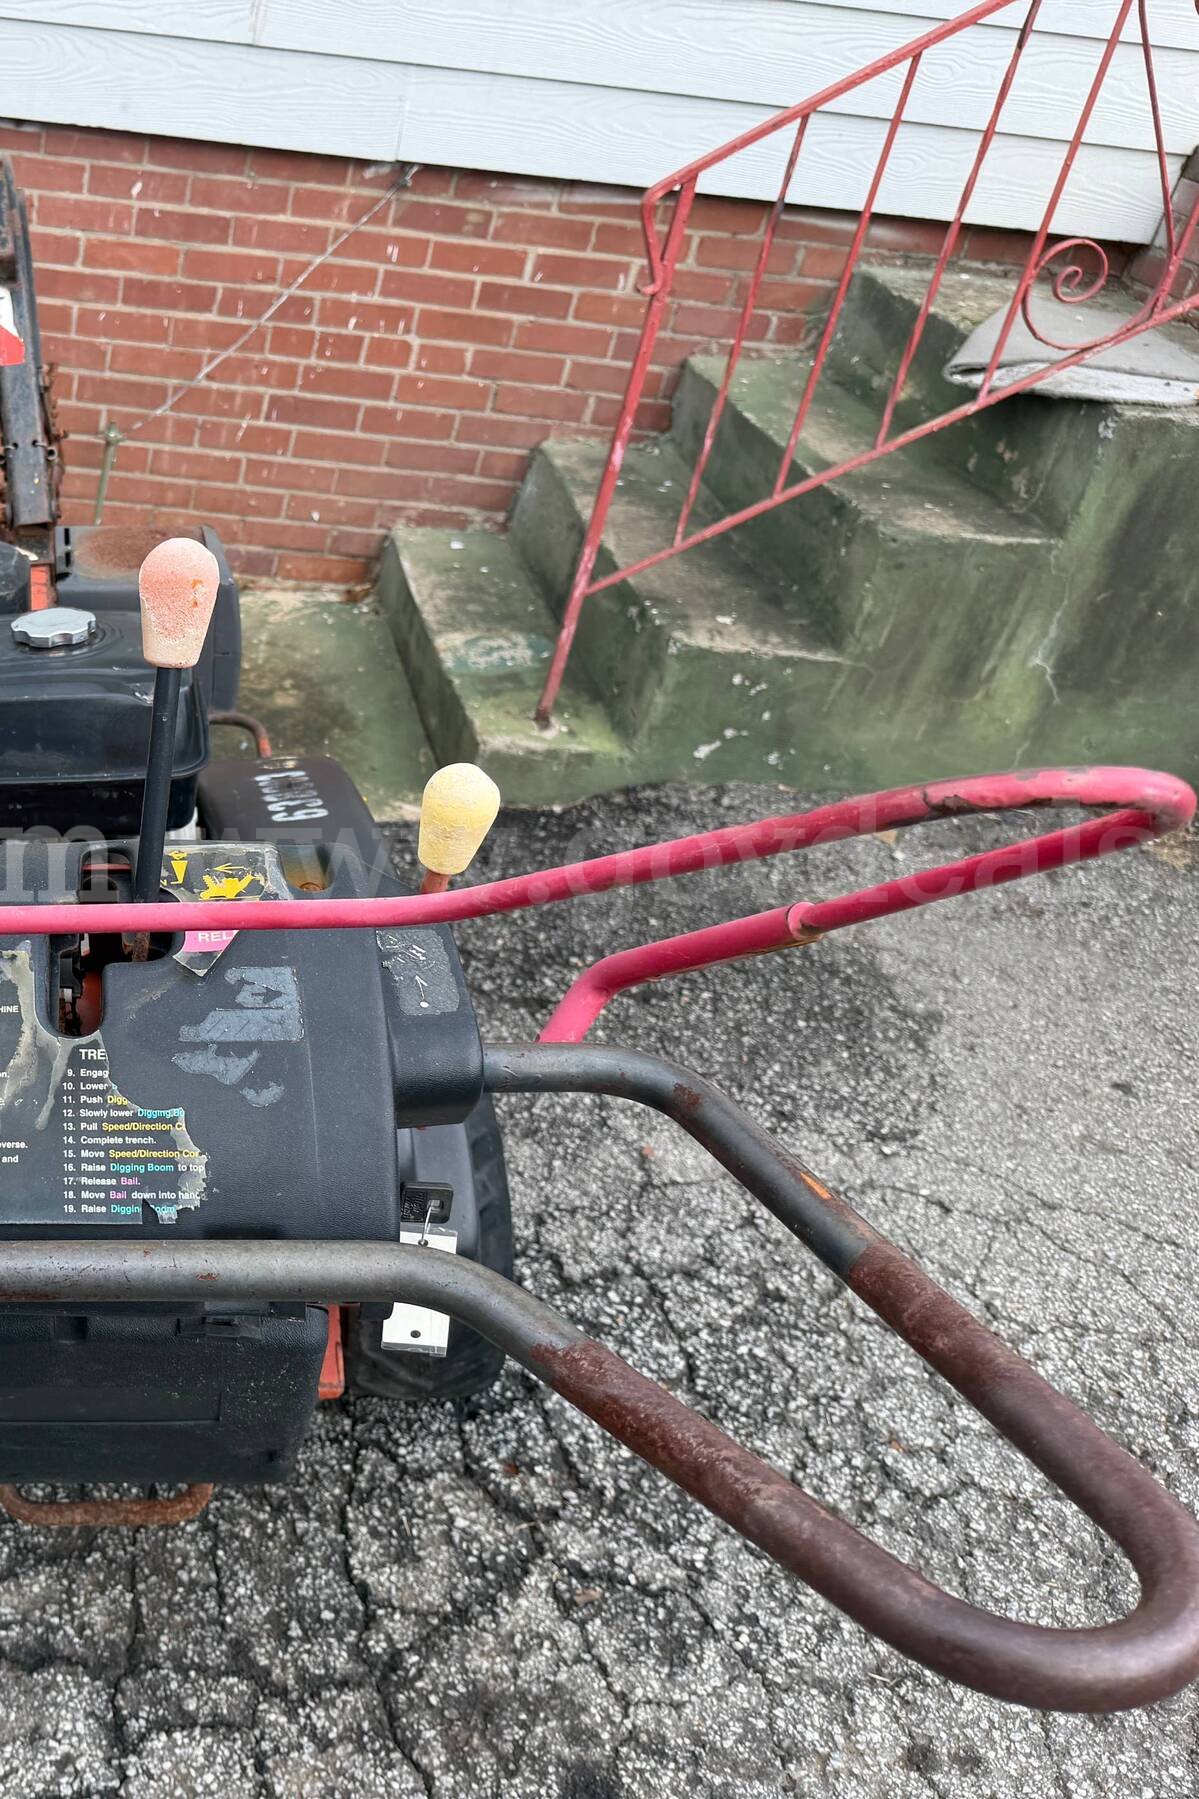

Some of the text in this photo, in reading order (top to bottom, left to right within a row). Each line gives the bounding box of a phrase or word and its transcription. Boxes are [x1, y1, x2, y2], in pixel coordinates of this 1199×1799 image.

[79, 1048, 106, 1060] TRE
[67, 1068, 76, 1077] 9.
[62, 1082, 76, 1090] 10.
[80, 1082, 108, 1090] Lower
[62, 1095, 128, 1105] 11. Push Digg
[62, 1109, 76, 1117] 12.
[80, 1108, 108, 1119] Slowly
[110, 1108, 134, 1117] lower
[137, 1108, 171, 1119] Digging
[62, 1122, 76, 1131] 13.
[80, 1122, 98, 1131] Pull
[102, 1122, 172, 1132] Speed/Direction
[62, 1135, 157, 1146] 14. Complete trench.
[1, 1155, 19, 1163] and
[63, 1150, 77, 1158] 15.
[80, 1150, 105, 1158] Move
[108, 1149, 180, 1160] Speed/Direction
[63, 1163, 77, 1172] 16.
[81, 1163, 106, 1172] Raise
[110, 1163, 145, 1173] Digging
[147, 1163, 174, 1172] Boom
[178, 1163, 187, 1172] to
[63, 1176, 141, 1185] 17. Release Bail.
[63, 1191, 77, 1199] 18.
[81, 1191, 105, 1199] Move
[110, 1190, 127, 1199] Bail
[131, 1190, 156, 1199] down
[158, 1190, 176, 1199] into
[63, 1205, 77, 1213] 19.
[81, 1205, 106, 1213] Raise
[151, 1204, 175, 1214] oom
